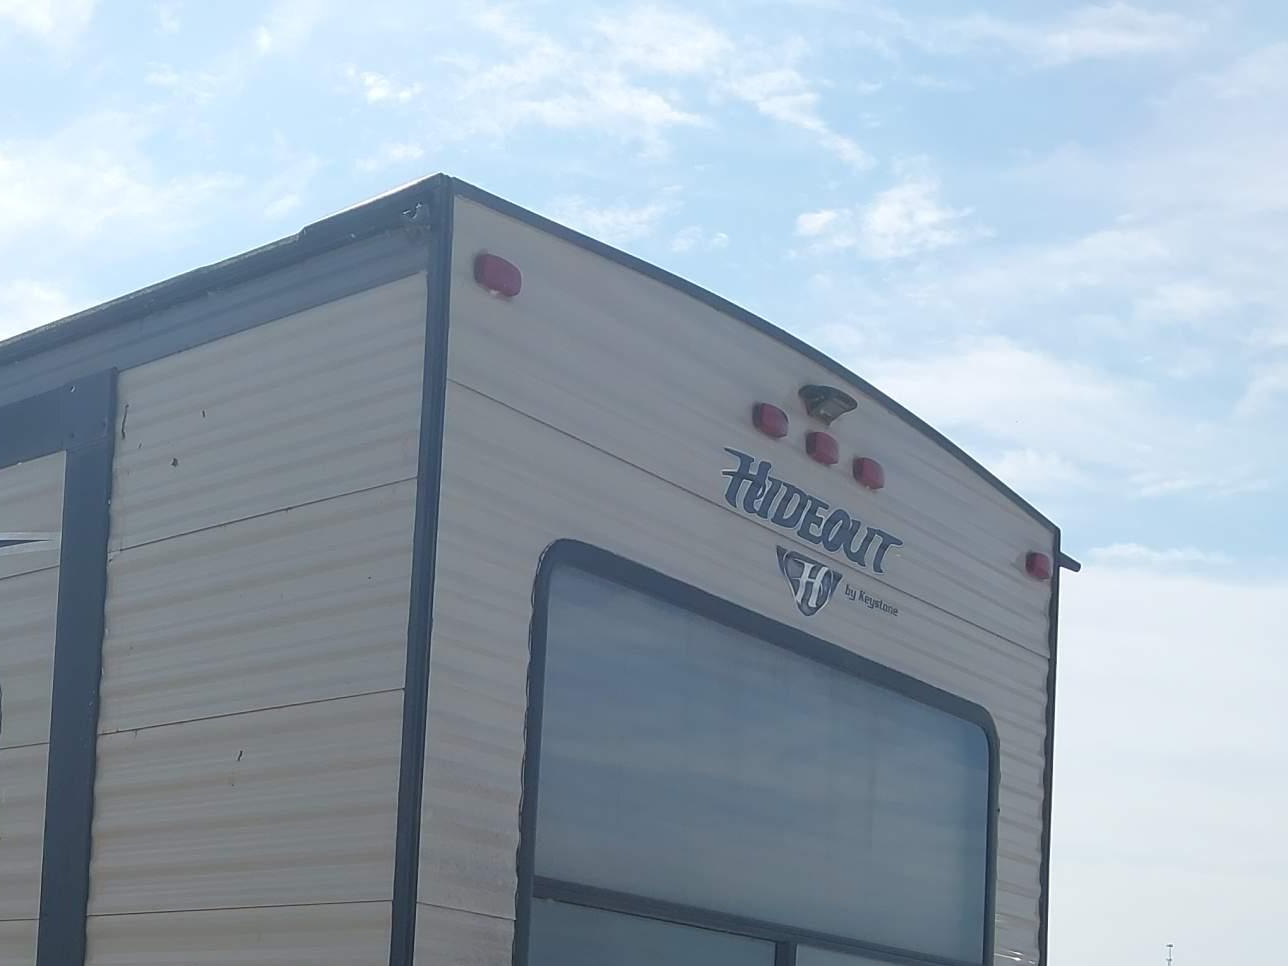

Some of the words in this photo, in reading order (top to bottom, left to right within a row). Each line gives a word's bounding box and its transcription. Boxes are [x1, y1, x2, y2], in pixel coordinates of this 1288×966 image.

[722, 447, 903, 574] HIDEOUT
[845, 584, 856, 601] by
[858, 590, 899, 617] Keystone
